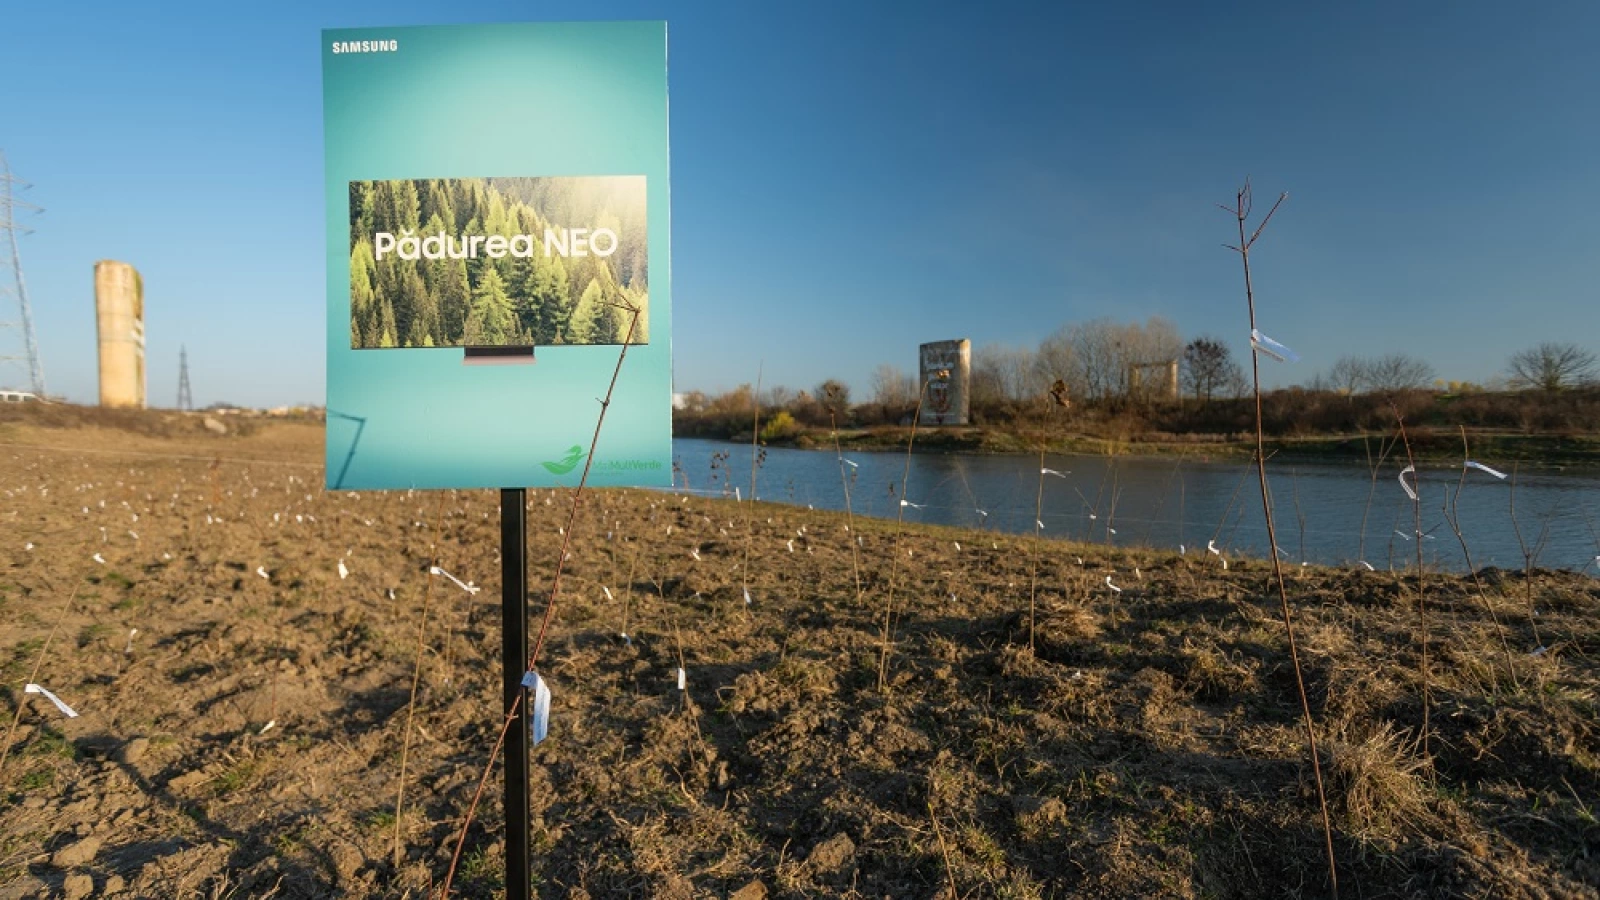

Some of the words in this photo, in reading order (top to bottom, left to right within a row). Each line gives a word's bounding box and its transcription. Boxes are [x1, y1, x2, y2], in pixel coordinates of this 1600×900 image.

[332, 39, 398, 54] SAMSUNG
[375, 229, 533, 261] Pădurea
[544, 227, 618, 258] NEO
